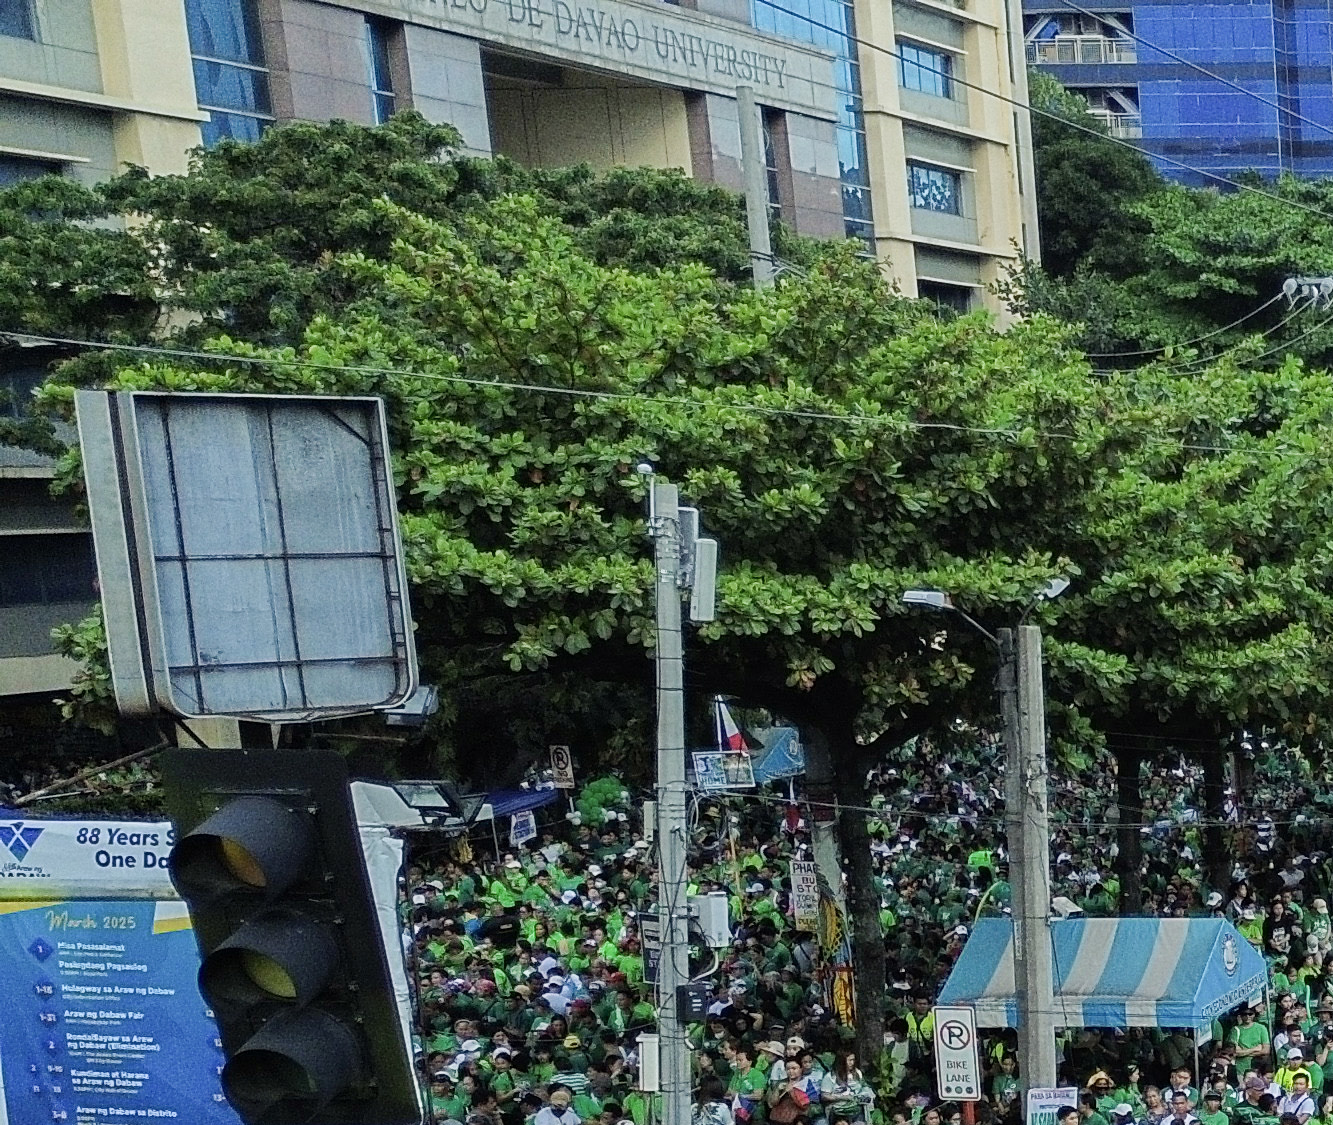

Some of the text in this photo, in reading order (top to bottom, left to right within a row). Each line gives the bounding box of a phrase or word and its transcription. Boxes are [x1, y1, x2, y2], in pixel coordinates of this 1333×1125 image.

[554, 3, 640, 51] DAVAO
[652, 24, 787, 89] UNIVERSITY
[76, 828, 175, 847] 88 Years S
[95, 850, 170, 869] One Da
[46, 911, 136, 931] March 2025
[114, 986, 134, 994] Araw
[148, 987, 175, 995] Dabaw
[64, 1010, 84, 1018] Araw
[99, 1010, 127, 1019] Dabaw
[946, 1060, 968, 1070] BIKE
[82, 1078, 103, 1086] Araw
[946, 1074, 971, 1083] LANE
[76, 1106, 96, 1114] Araw
[97, 1108, 108, 1116] ng
